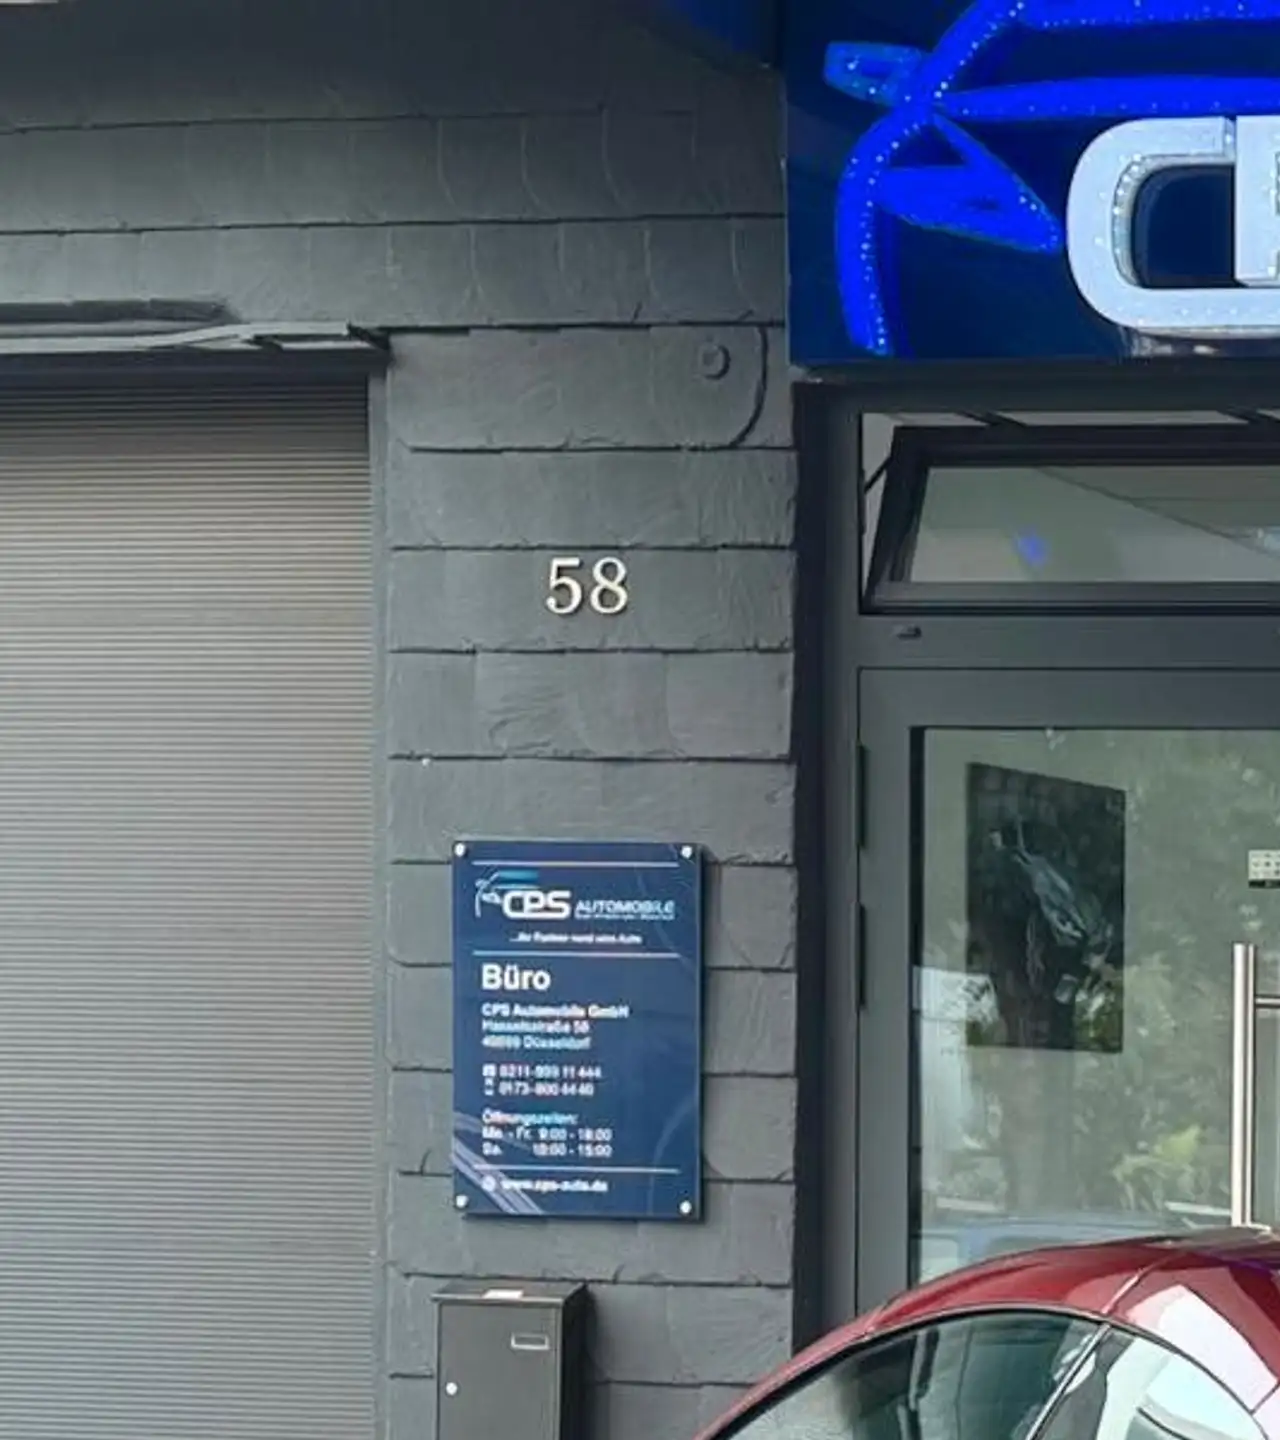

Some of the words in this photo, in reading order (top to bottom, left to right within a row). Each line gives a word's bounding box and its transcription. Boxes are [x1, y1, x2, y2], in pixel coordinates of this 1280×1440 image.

[546, 556, 628, 614] 58
[502, 889, 572, 919] CPS
[575, 900, 674, 914] AUTOMOBILE
[481, 963, 551, 991] Büro
